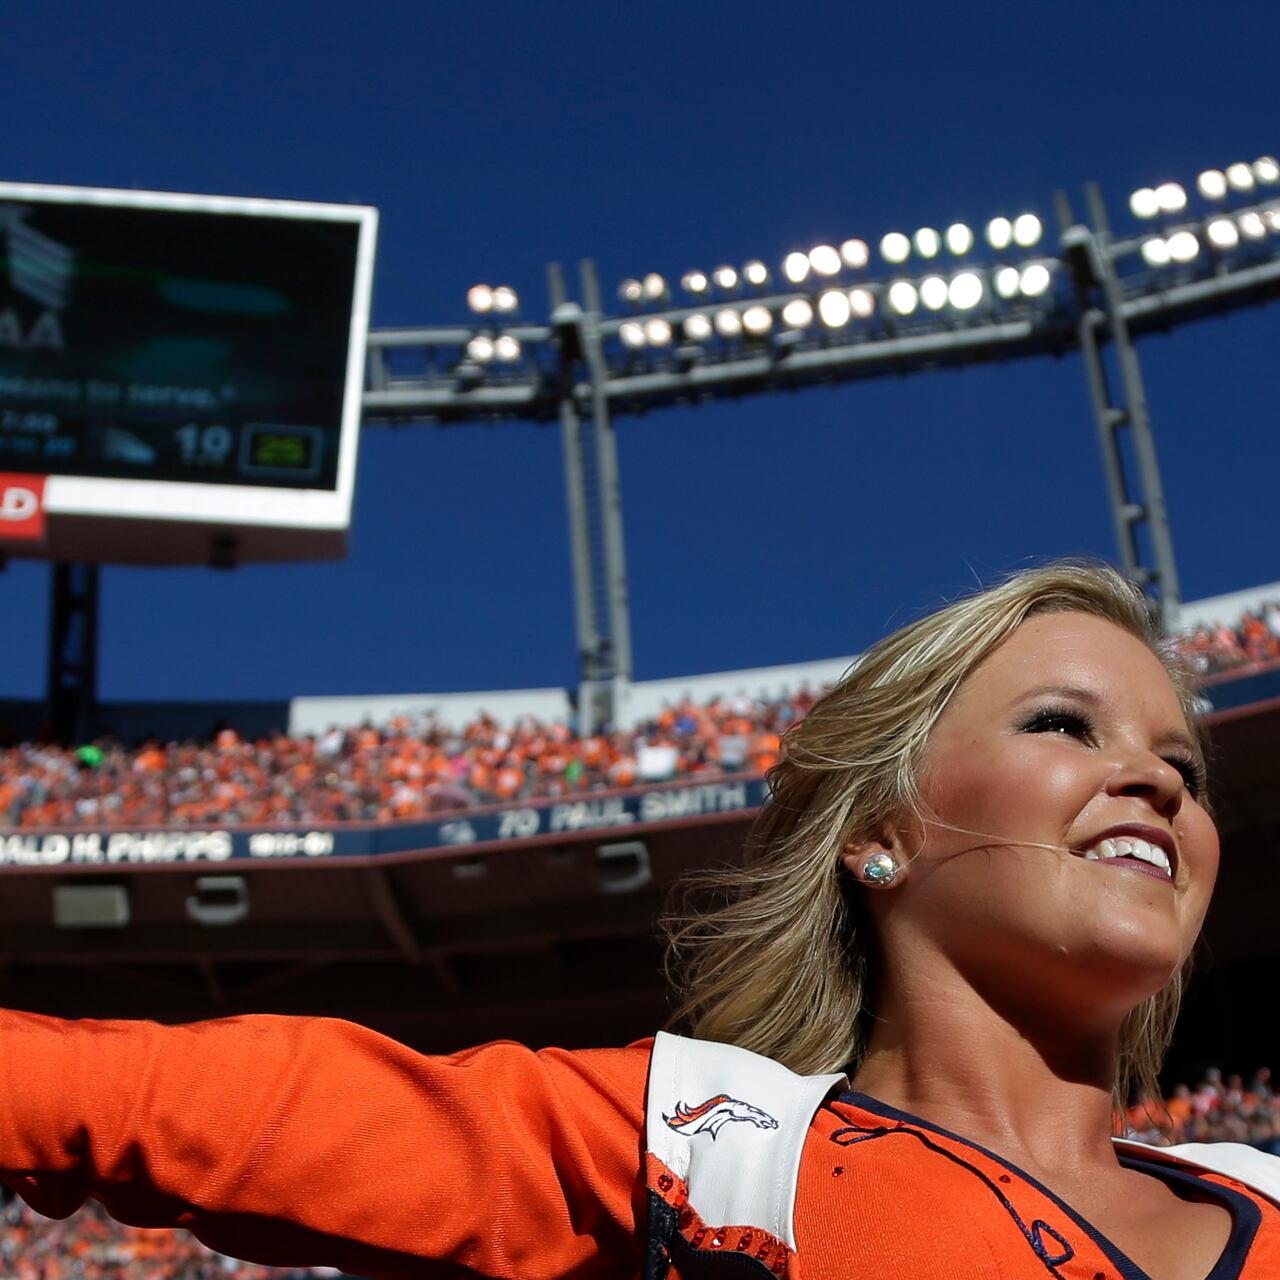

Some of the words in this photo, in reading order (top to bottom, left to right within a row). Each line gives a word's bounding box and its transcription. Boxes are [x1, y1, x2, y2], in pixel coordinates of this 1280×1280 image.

[550, 797, 635, 833] PAUL
[640, 784, 747, 822] SMITH
[107, 829, 233, 863] PHIPPS
